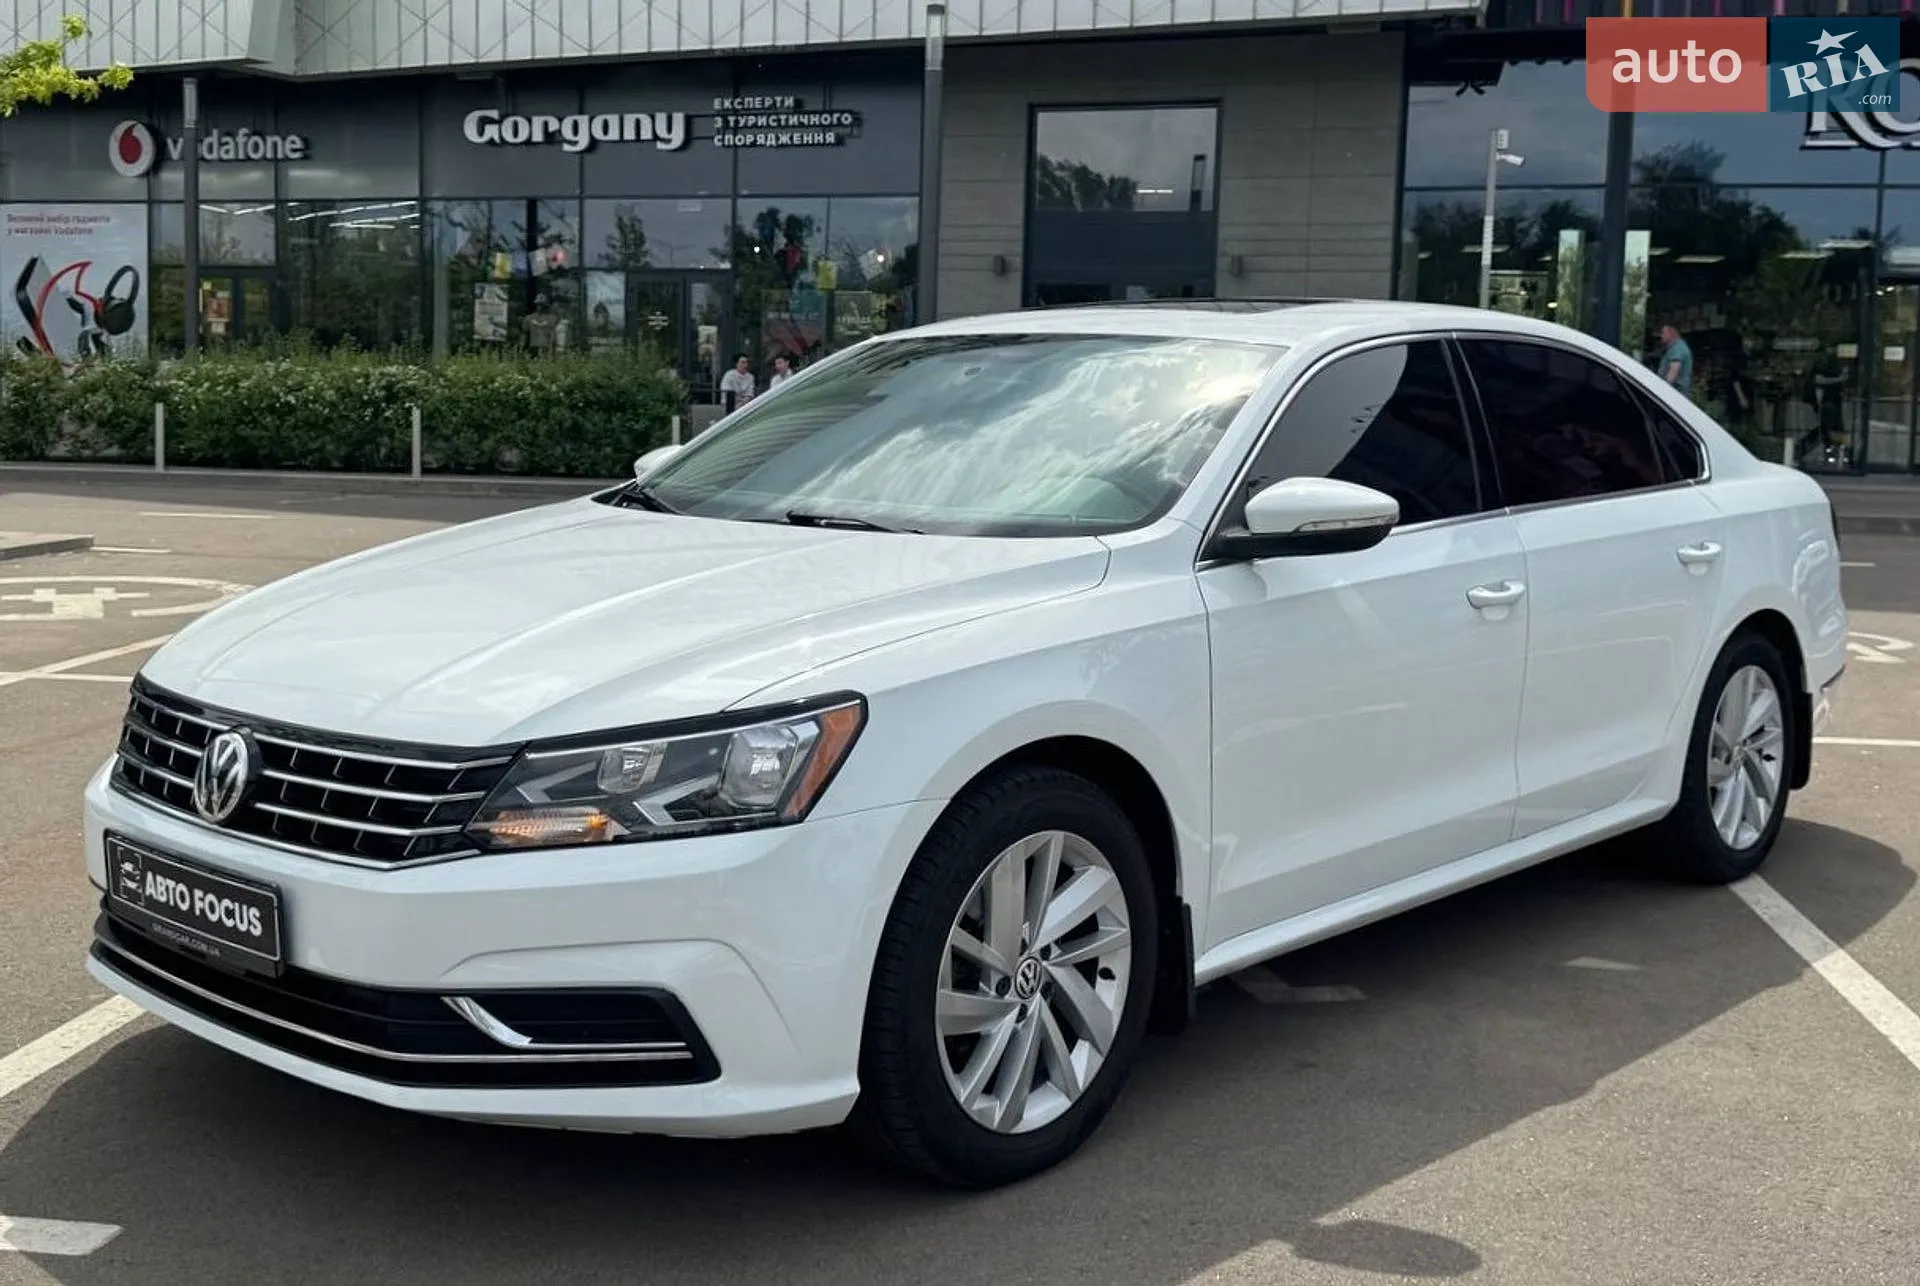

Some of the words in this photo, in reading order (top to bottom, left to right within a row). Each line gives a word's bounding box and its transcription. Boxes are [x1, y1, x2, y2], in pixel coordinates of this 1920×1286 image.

[713, 96, 795, 109] ЕКСПЕРТИ
[463, 109, 686, 152] Gorgany
[728, 113, 853, 127] ТУРИСТИЧНОГО
[166, 127, 305, 160] vdafone
[713, 132, 836, 147] СПОРЯДЖЕННЯ
[193, 889, 263, 936] FOCUS
